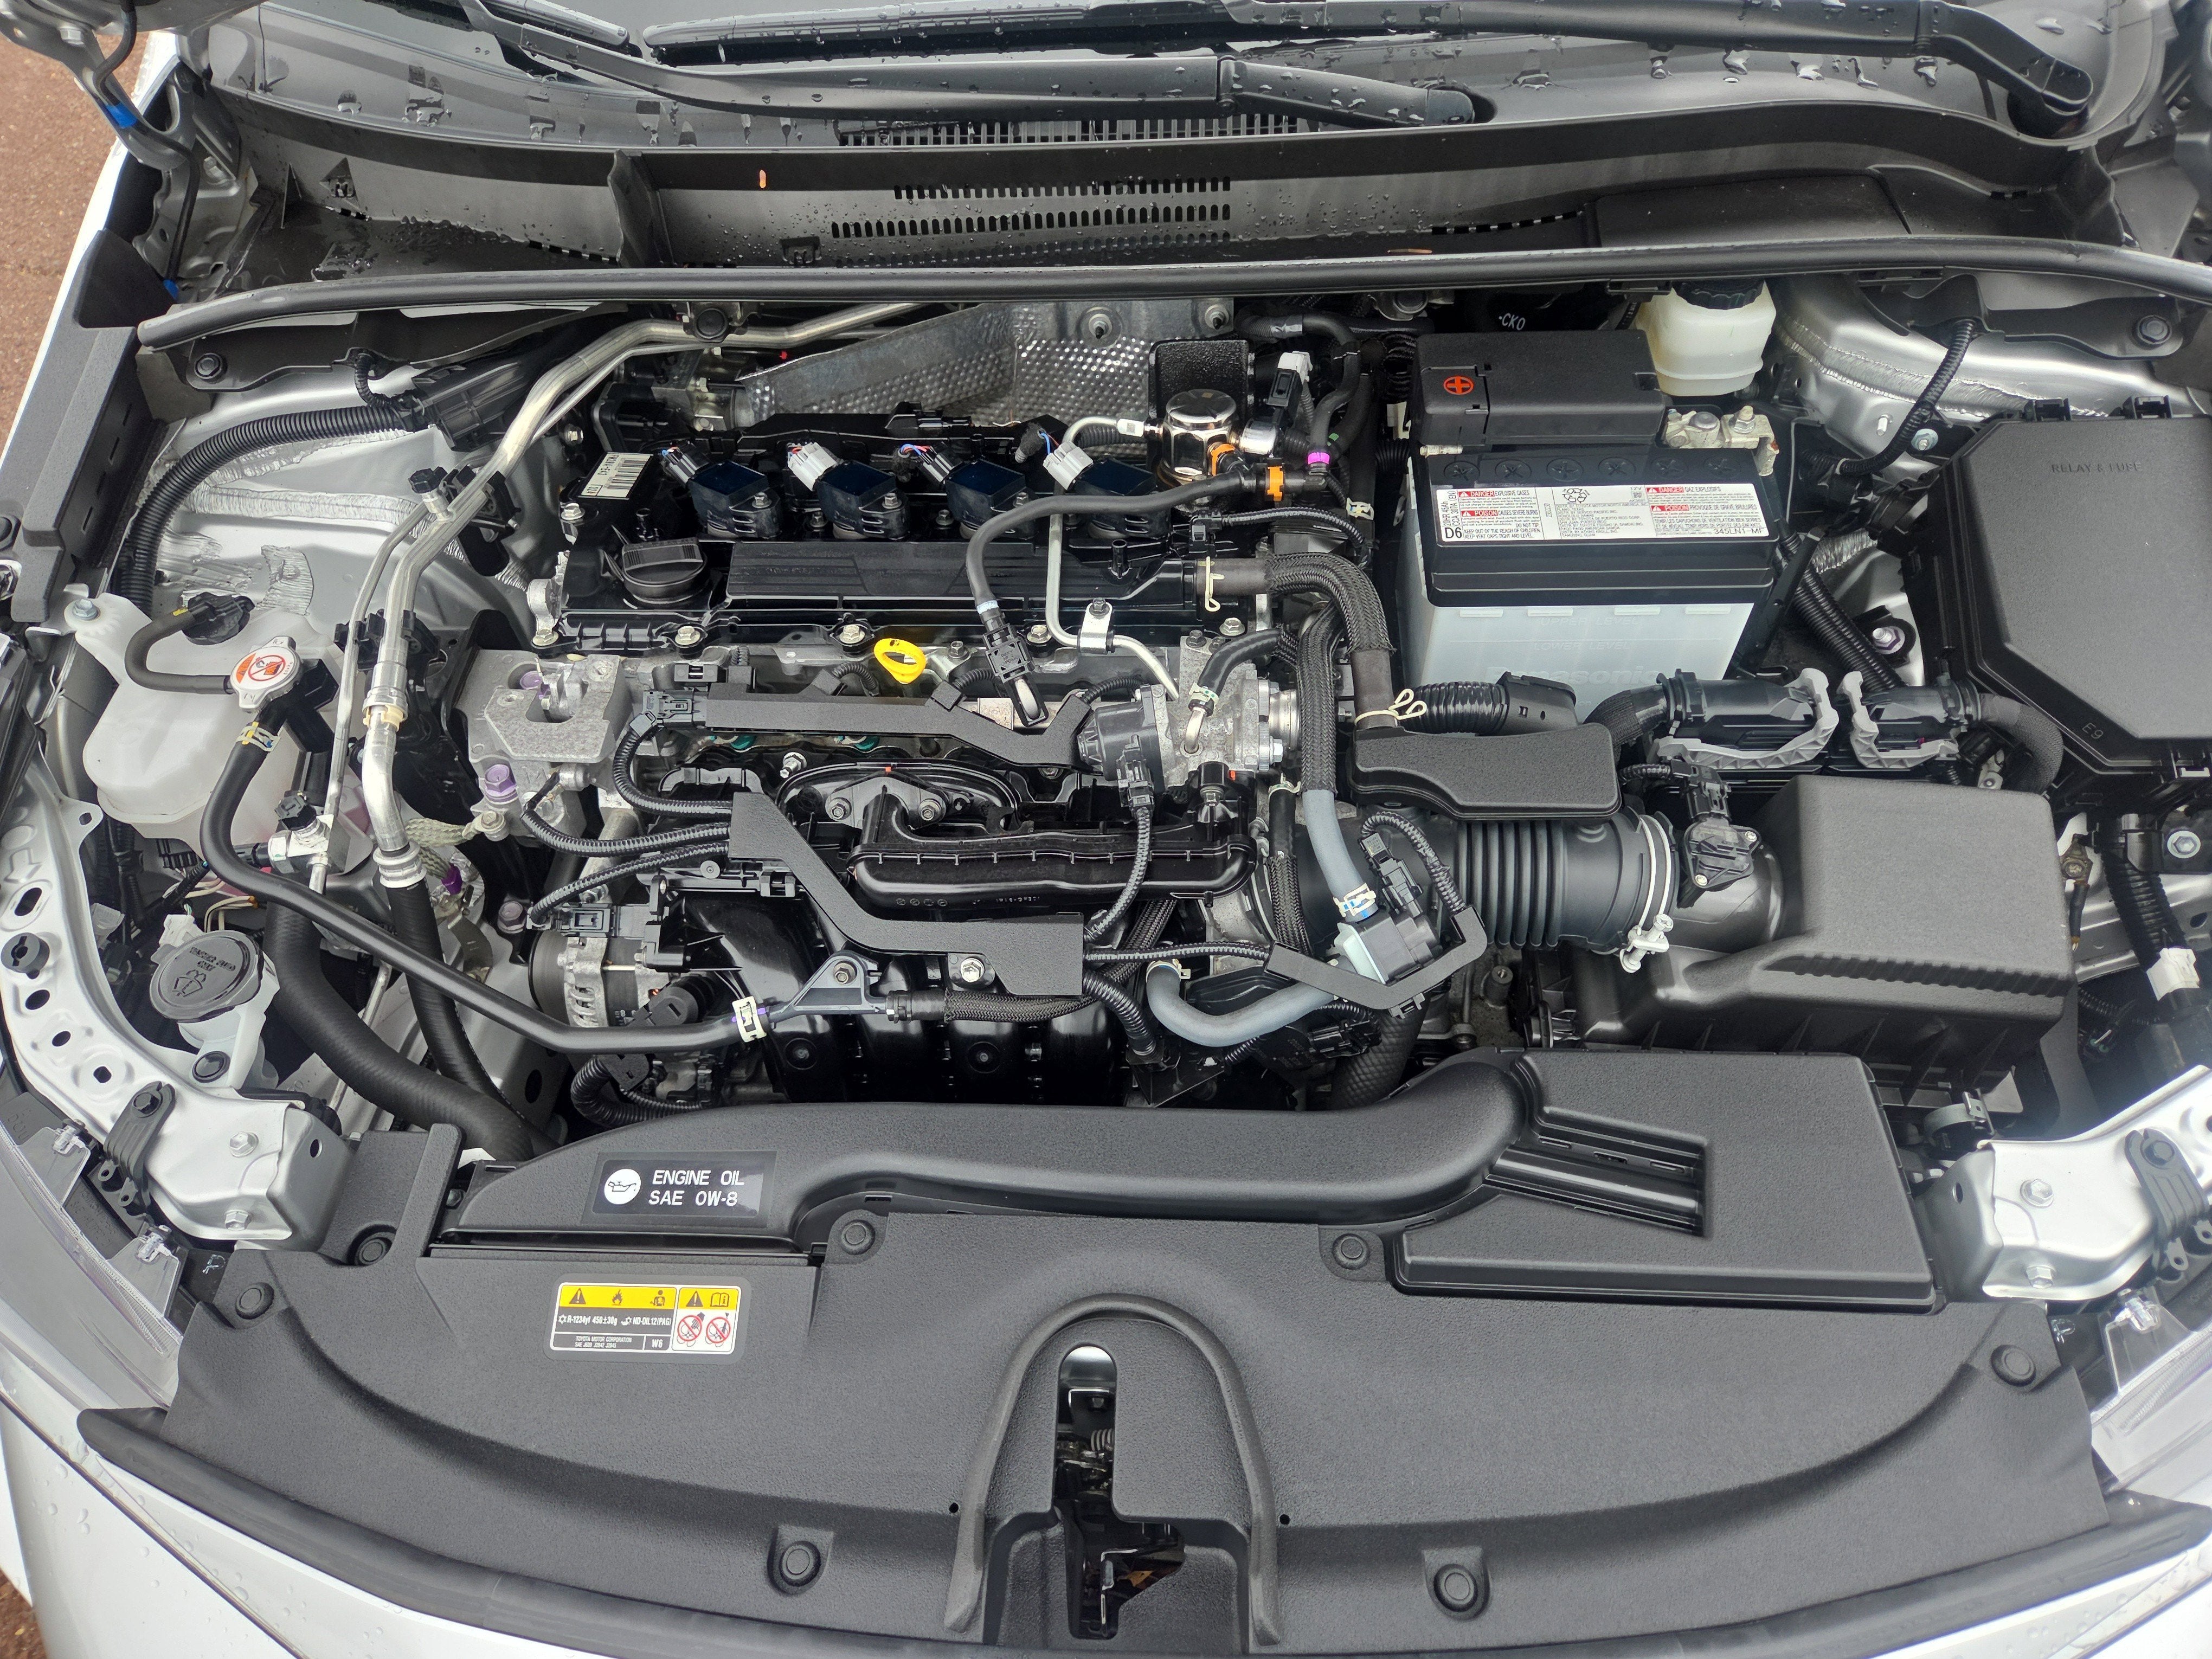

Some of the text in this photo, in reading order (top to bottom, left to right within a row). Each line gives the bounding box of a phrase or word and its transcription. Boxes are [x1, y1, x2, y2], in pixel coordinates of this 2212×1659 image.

[2051, 463, 2092, 473] RELAY
[1451, 515, 1460, 526] CCA
[1445, 527, 1462, 538] D6
[1540, 617, 1641, 626] UPPER LEVEL
[1534, 642, 1630, 651] LOWER LEVEL
[1486, 666, 1661, 685] Pnasonic
[2082, 722, 2104, 739] E9
[652, 1169, 745, 1186] ENGINE OIL
[648, 1190, 738, 1207] SAE 0W-8
[592, 1316, 618, 1326] 450±30g
[651, 1339, 663, 1348] W6
